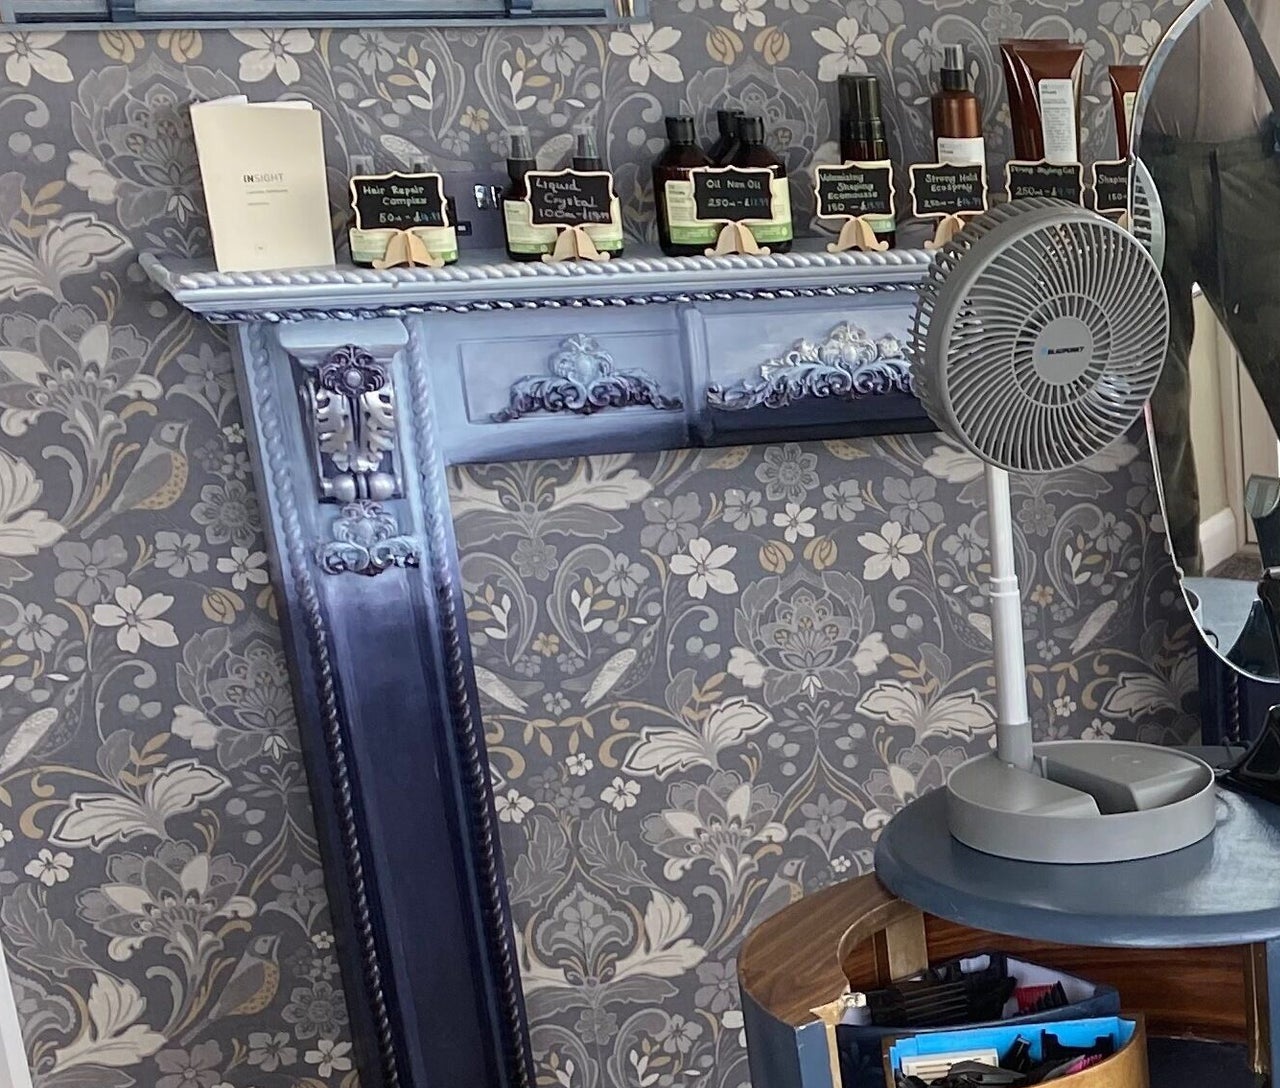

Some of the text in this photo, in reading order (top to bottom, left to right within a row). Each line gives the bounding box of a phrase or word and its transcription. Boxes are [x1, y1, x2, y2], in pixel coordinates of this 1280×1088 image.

[243, 173, 284, 183] INSIGHT
[535, 178, 582, 193] Liquid
[706, 180, 721, 189] Oil
[747, 180, 761, 189] Oil
[363, 185, 424, 196] Hair Repair
[382, 197, 427, 207] Complex
[544, 193, 598, 210] Crystal
